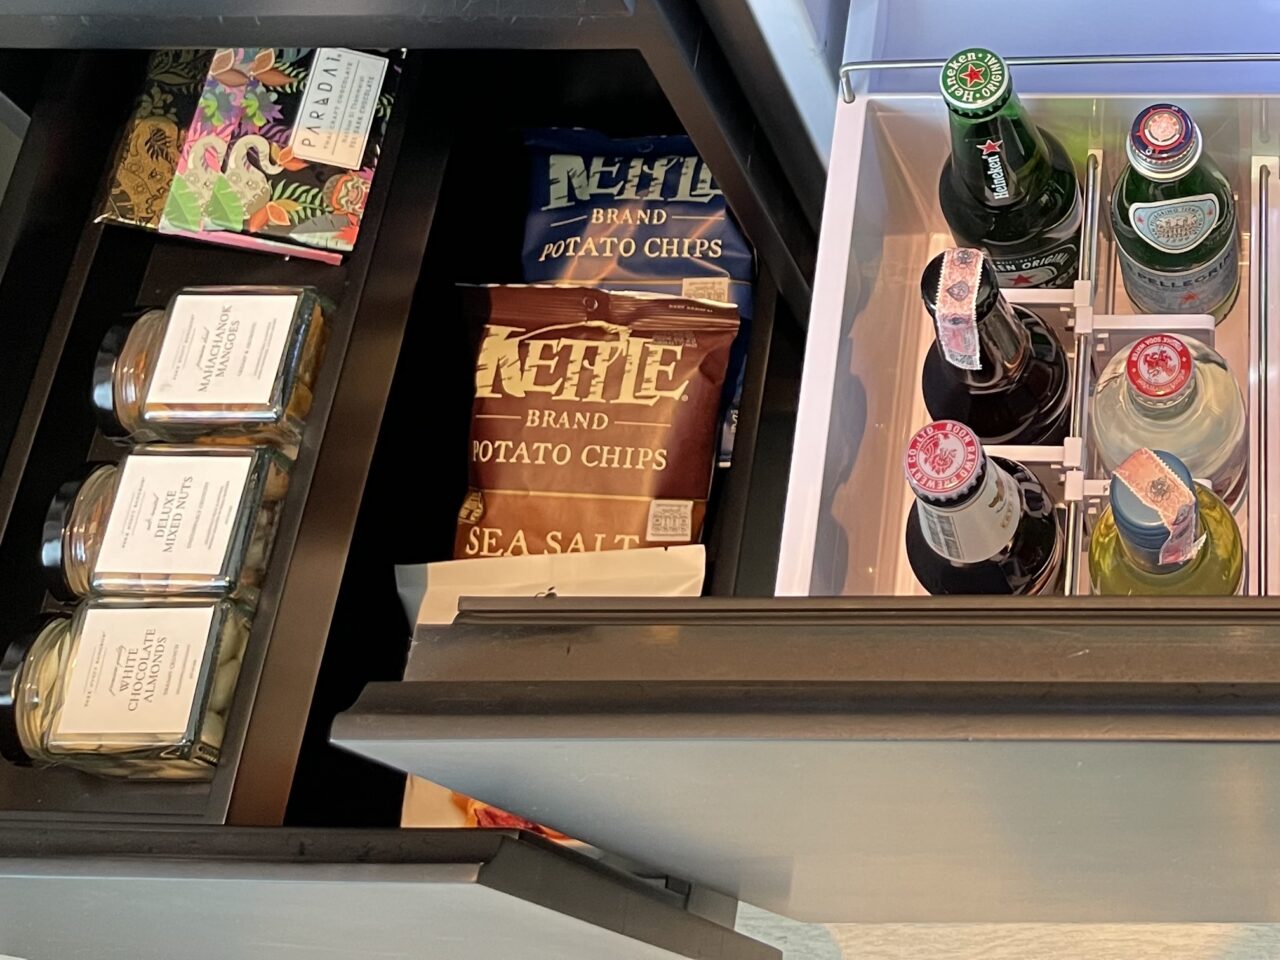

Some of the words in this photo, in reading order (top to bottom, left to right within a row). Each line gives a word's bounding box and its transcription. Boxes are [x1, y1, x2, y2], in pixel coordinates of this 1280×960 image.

[337, 62, 353, 104] CHOCOLATE
[946, 52, 977, 102] Heineken
[982, 53, 1002, 97] ORIGINAL
[986, 154, 1009, 200] Heineken
[591, 208, 667, 225] BRAND
[538, 236, 636, 262] POTATO
[644, 238, 722, 258] CHIPS
[198, 304, 232, 393] MAHACHANOK
[215, 320, 240, 377] MANGOES
[475, 321, 690, 406] KETTLE
[526, 409, 609, 430] BRAND
[945, 423, 970, 443] BOON
[472, 440, 571, 465] POTATO
[581, 444, 667, 471] CHIPS
[960, 447, 976, 477] RAWD
[909, 467, 957, 490] BREWERY
[154, 490, 177, 538] DELUXE
[163, 513, 183, 553] MIXED
[175, 476, 194, 510] NUTS
[465, 526, 530, 557] SEA
[544, 530, 640, 556] SALT
[119, 648, 139, 693] WHITE
[127, 628, 157, 712] CHOCOLATE
[143, 636, 168, 703] ALMONDS
